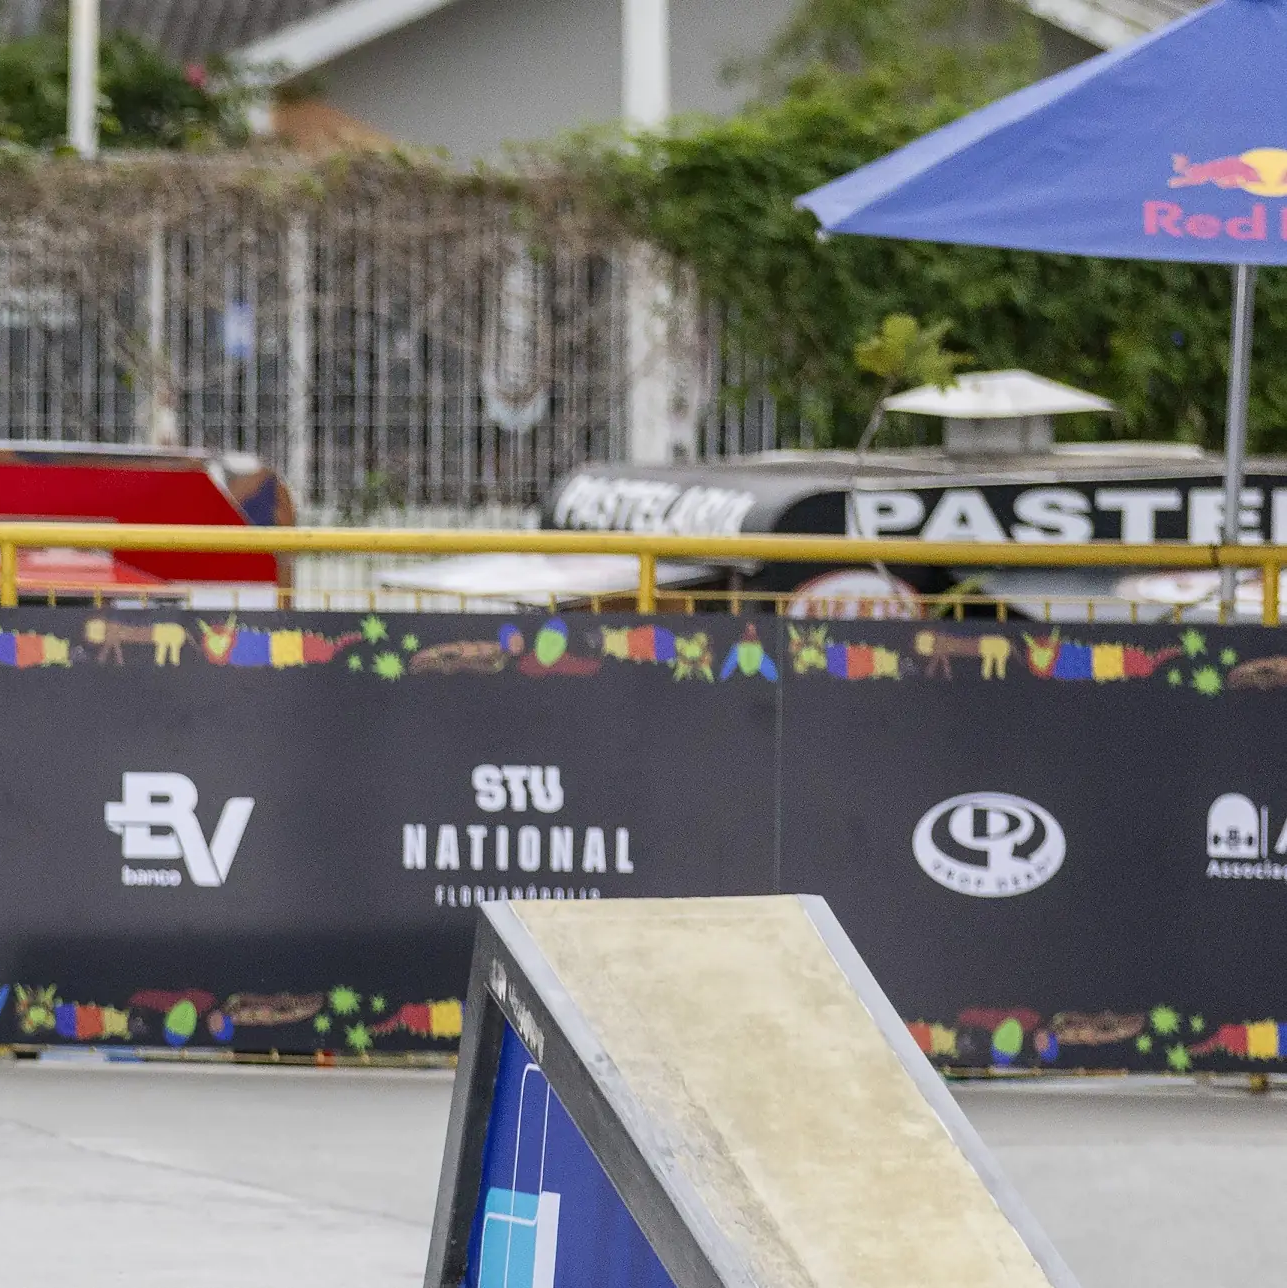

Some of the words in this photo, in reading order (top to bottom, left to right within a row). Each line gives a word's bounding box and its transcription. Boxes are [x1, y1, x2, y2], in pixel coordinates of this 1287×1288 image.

[1142, 200, 1267, 241] Red
[849, 488, 1287, 546] PASTE
[472, 764, 564, 813] STU
[104, 771, 255, 887] BV
[403, 823, 634, 874] NATIONAL
[121, 864, 182, 886] banco
